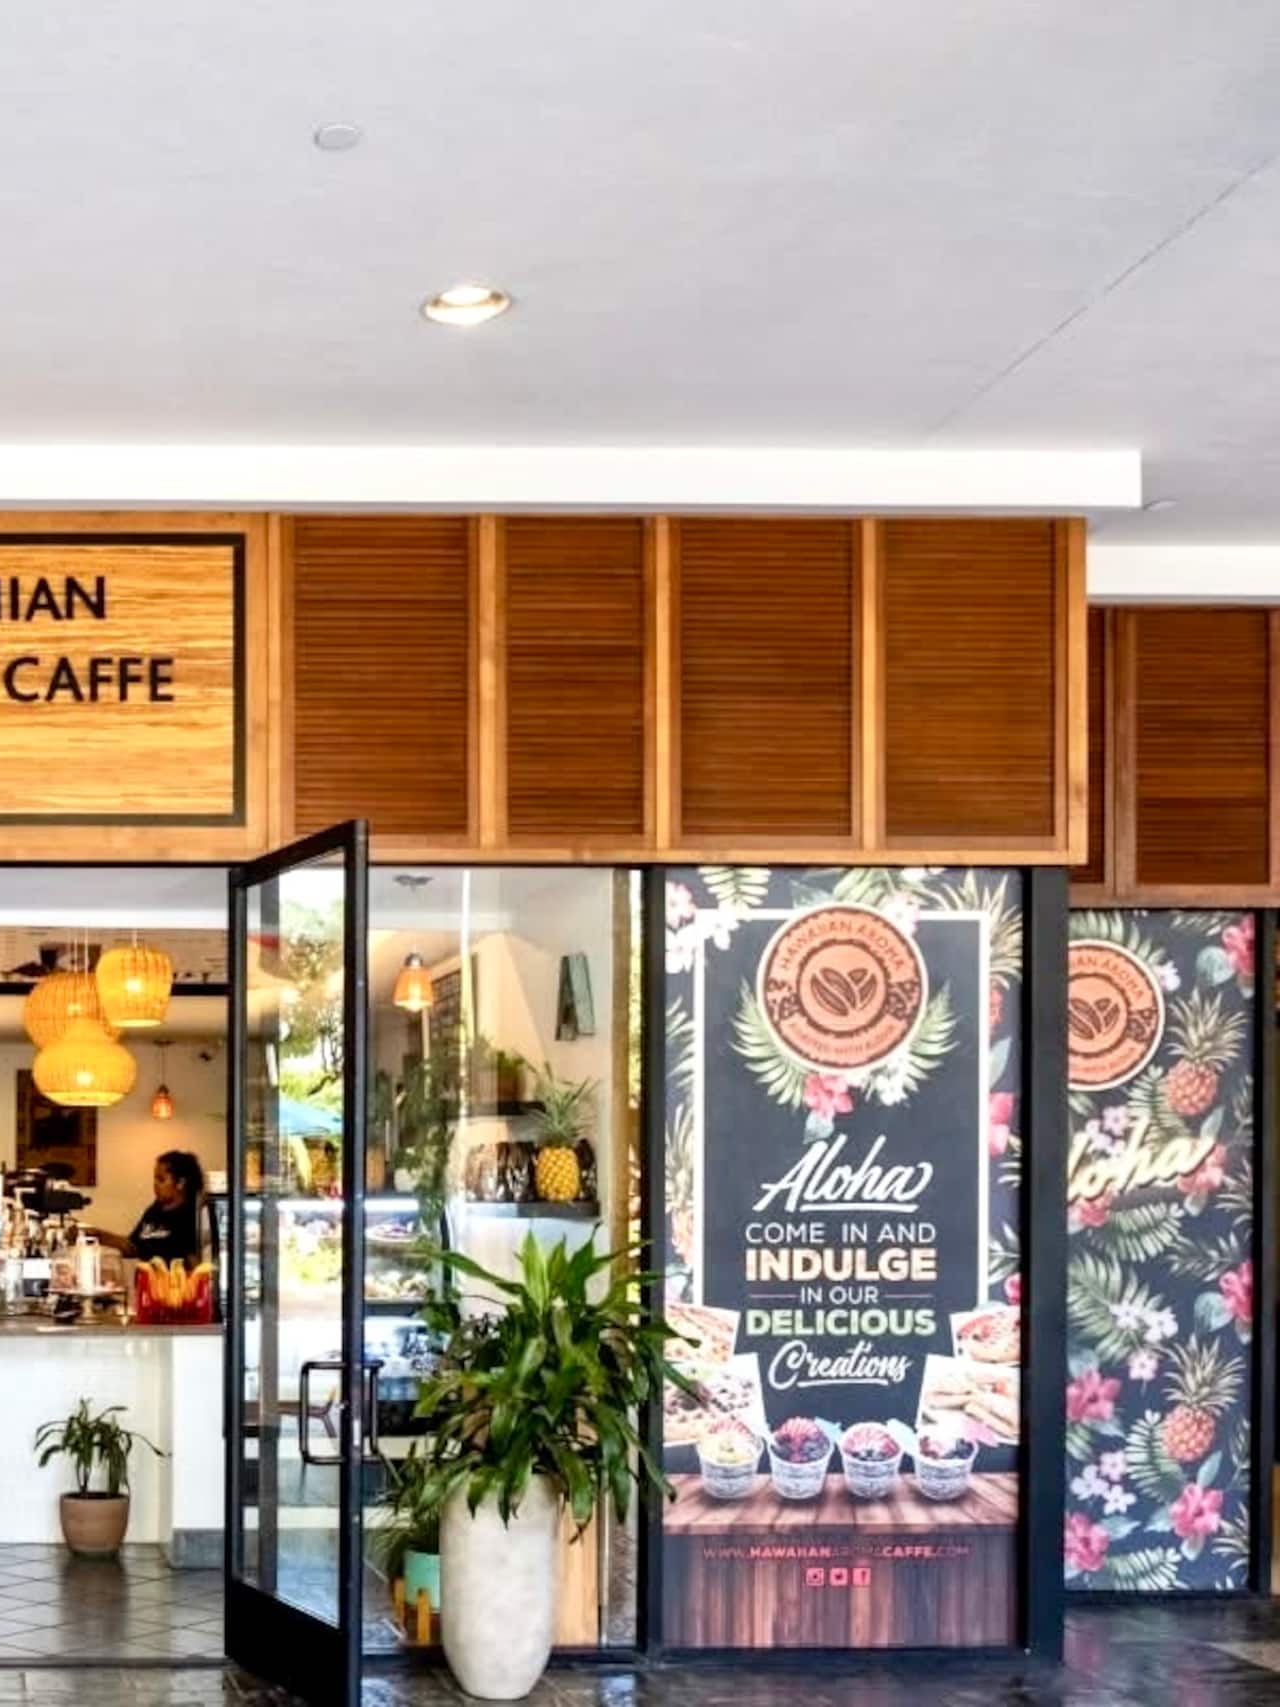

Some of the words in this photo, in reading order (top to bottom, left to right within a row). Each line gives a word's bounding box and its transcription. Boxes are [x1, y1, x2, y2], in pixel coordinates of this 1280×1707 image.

[3, 656, 176, 702] CAFFE
[857, 923, 906, 970] AROMA
[752, 1136, 934, 1213] Aloha
[1068, 1117, 1215, 1202] loha
[745, 1222, 825, 1244] COME
[842, 1222, 867, 1244] IN
[877, 1222, 937, 1244] AND
[745, 1247, 938, 1281] INDULGE
[800, 1286, 822, 1304] IN
[829, 1286, 879, 1304] OUR
[746, 1308, 937, 1336] DELICIOUS
[768, 1339, 912, 1390] Creations
